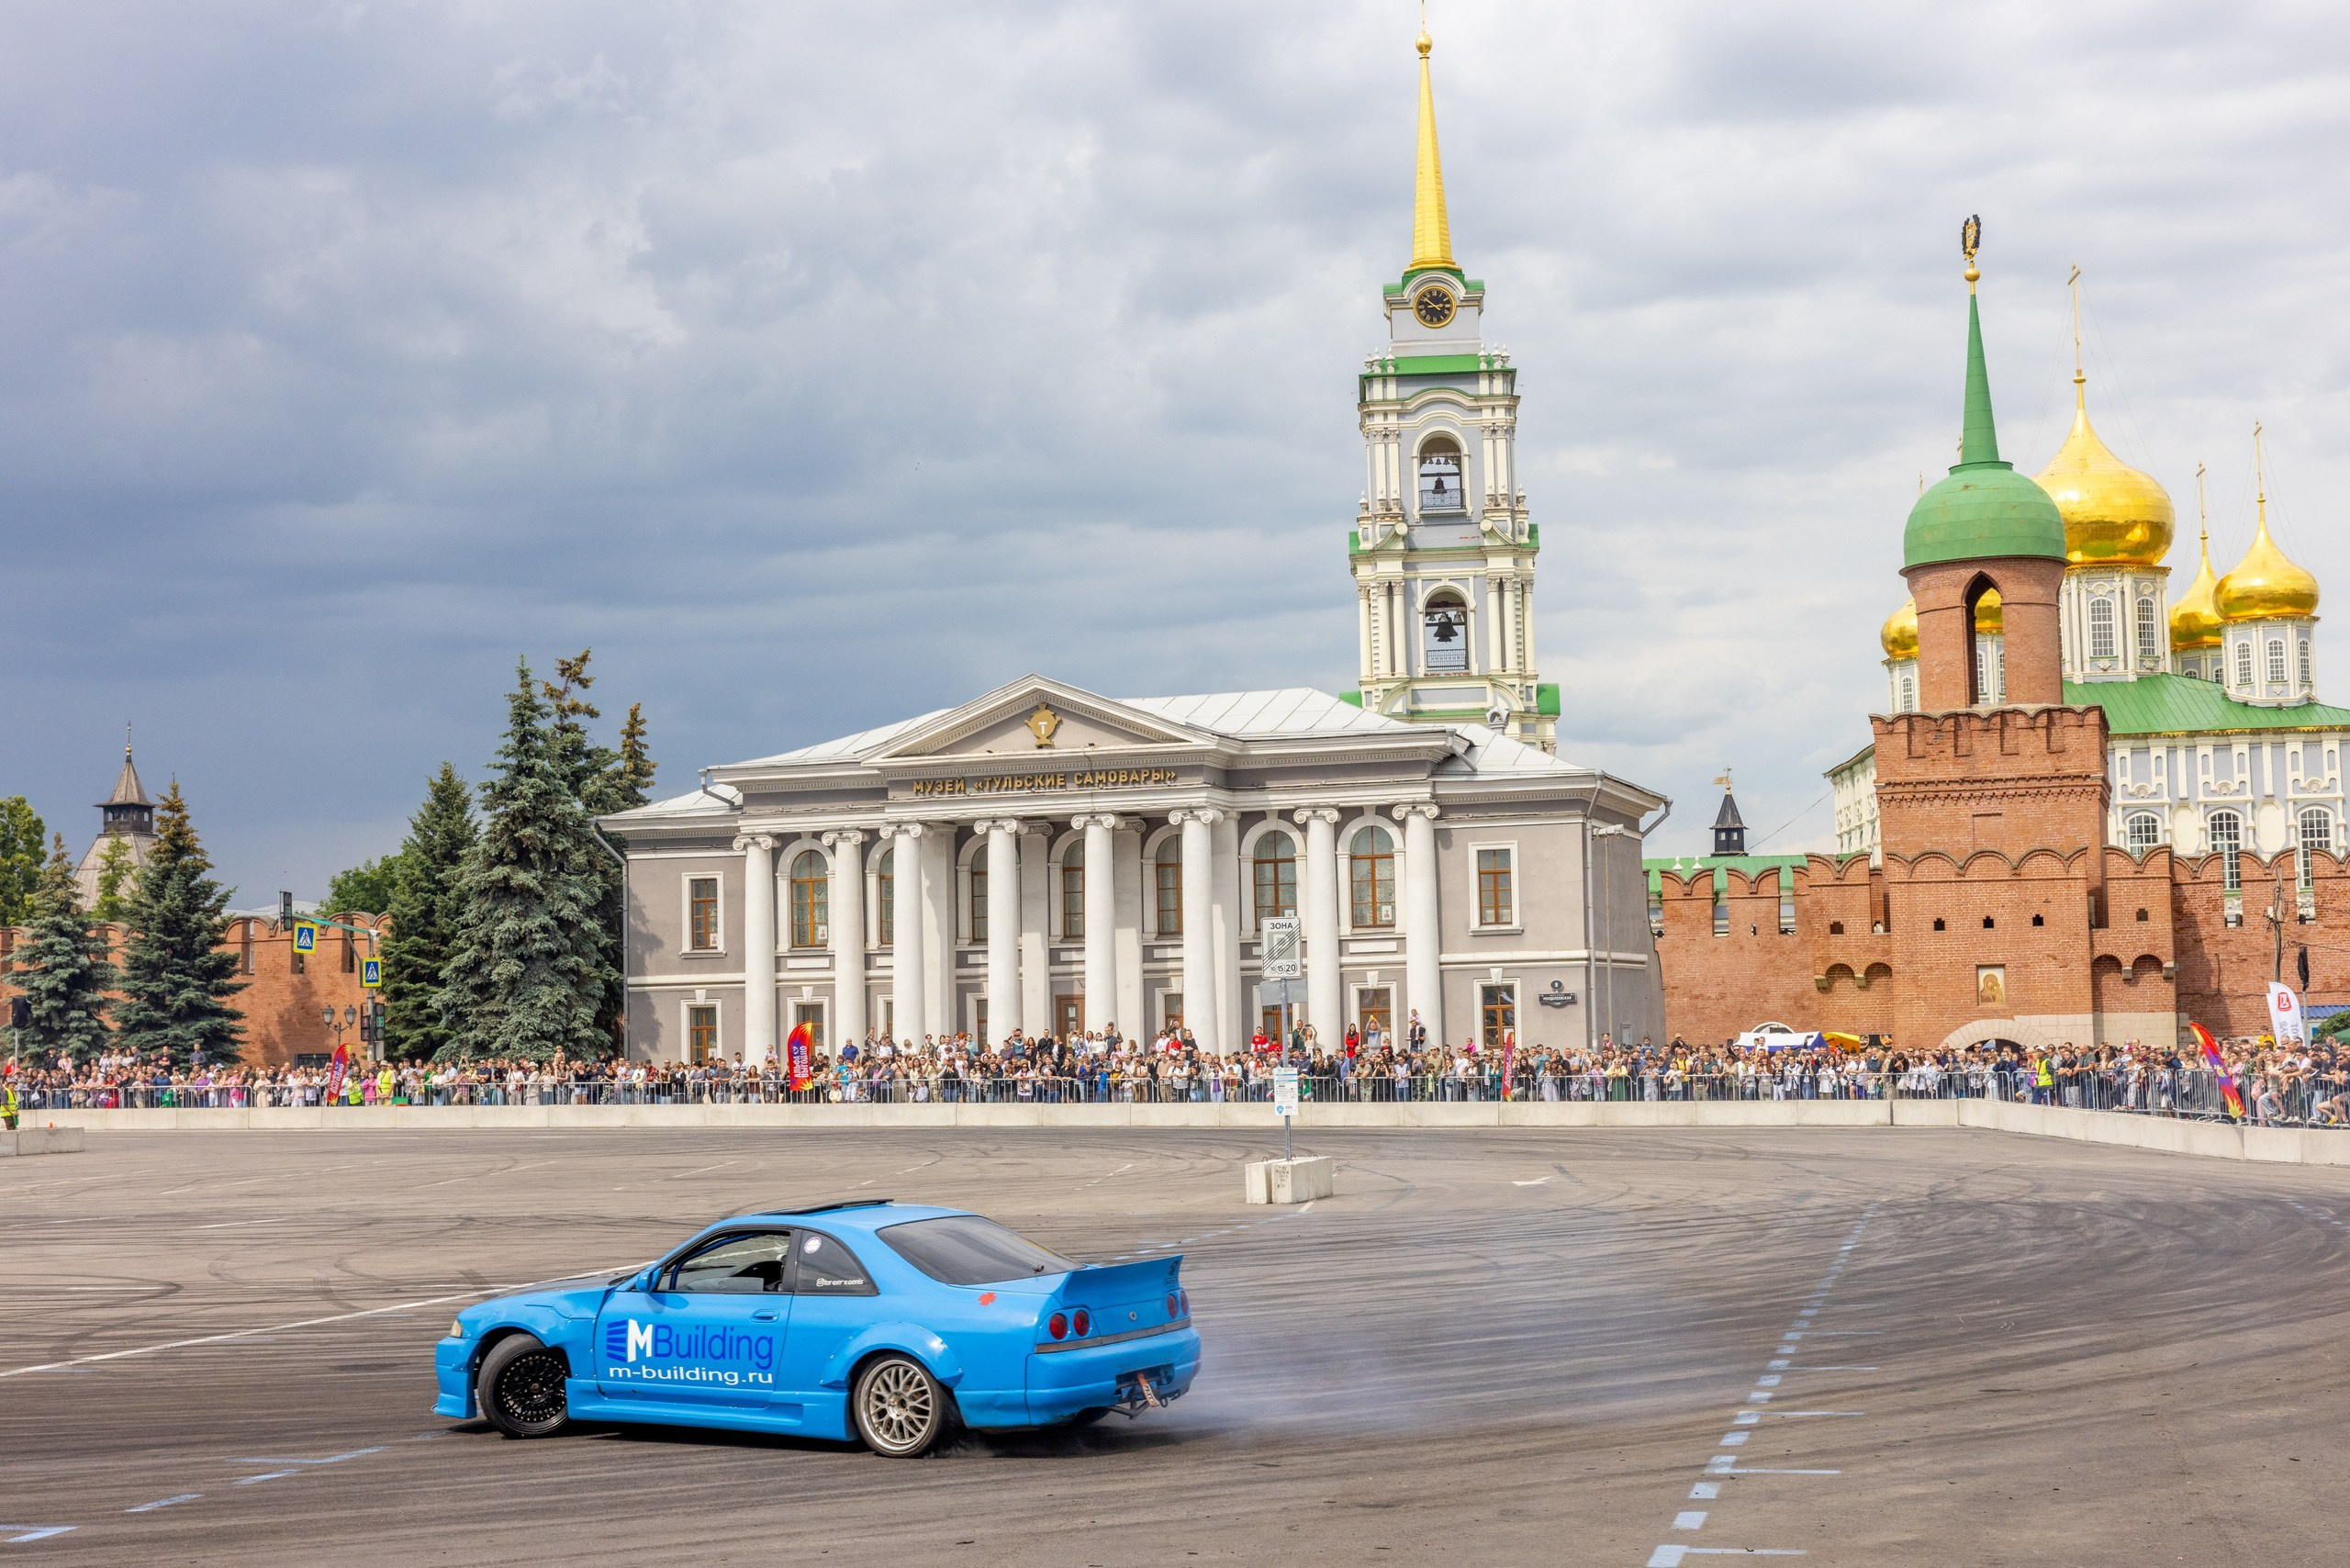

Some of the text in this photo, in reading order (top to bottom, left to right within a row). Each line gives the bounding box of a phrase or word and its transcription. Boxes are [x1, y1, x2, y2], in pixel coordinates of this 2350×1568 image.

[912, 767, 1176, 793] МУЗЕЙ «ТУЛЬСКИЕ САМОВАРЫ»
[1270, 922, 1293, 930] ЗОНА
[1286, 963, 1296, 972] 20
[793, 1055, 801, 1078] АЛЬФА
[800, 1046, 809, 1078] ВЫГОДНО
[609, 1365, 773, 1385] m-building.ru
